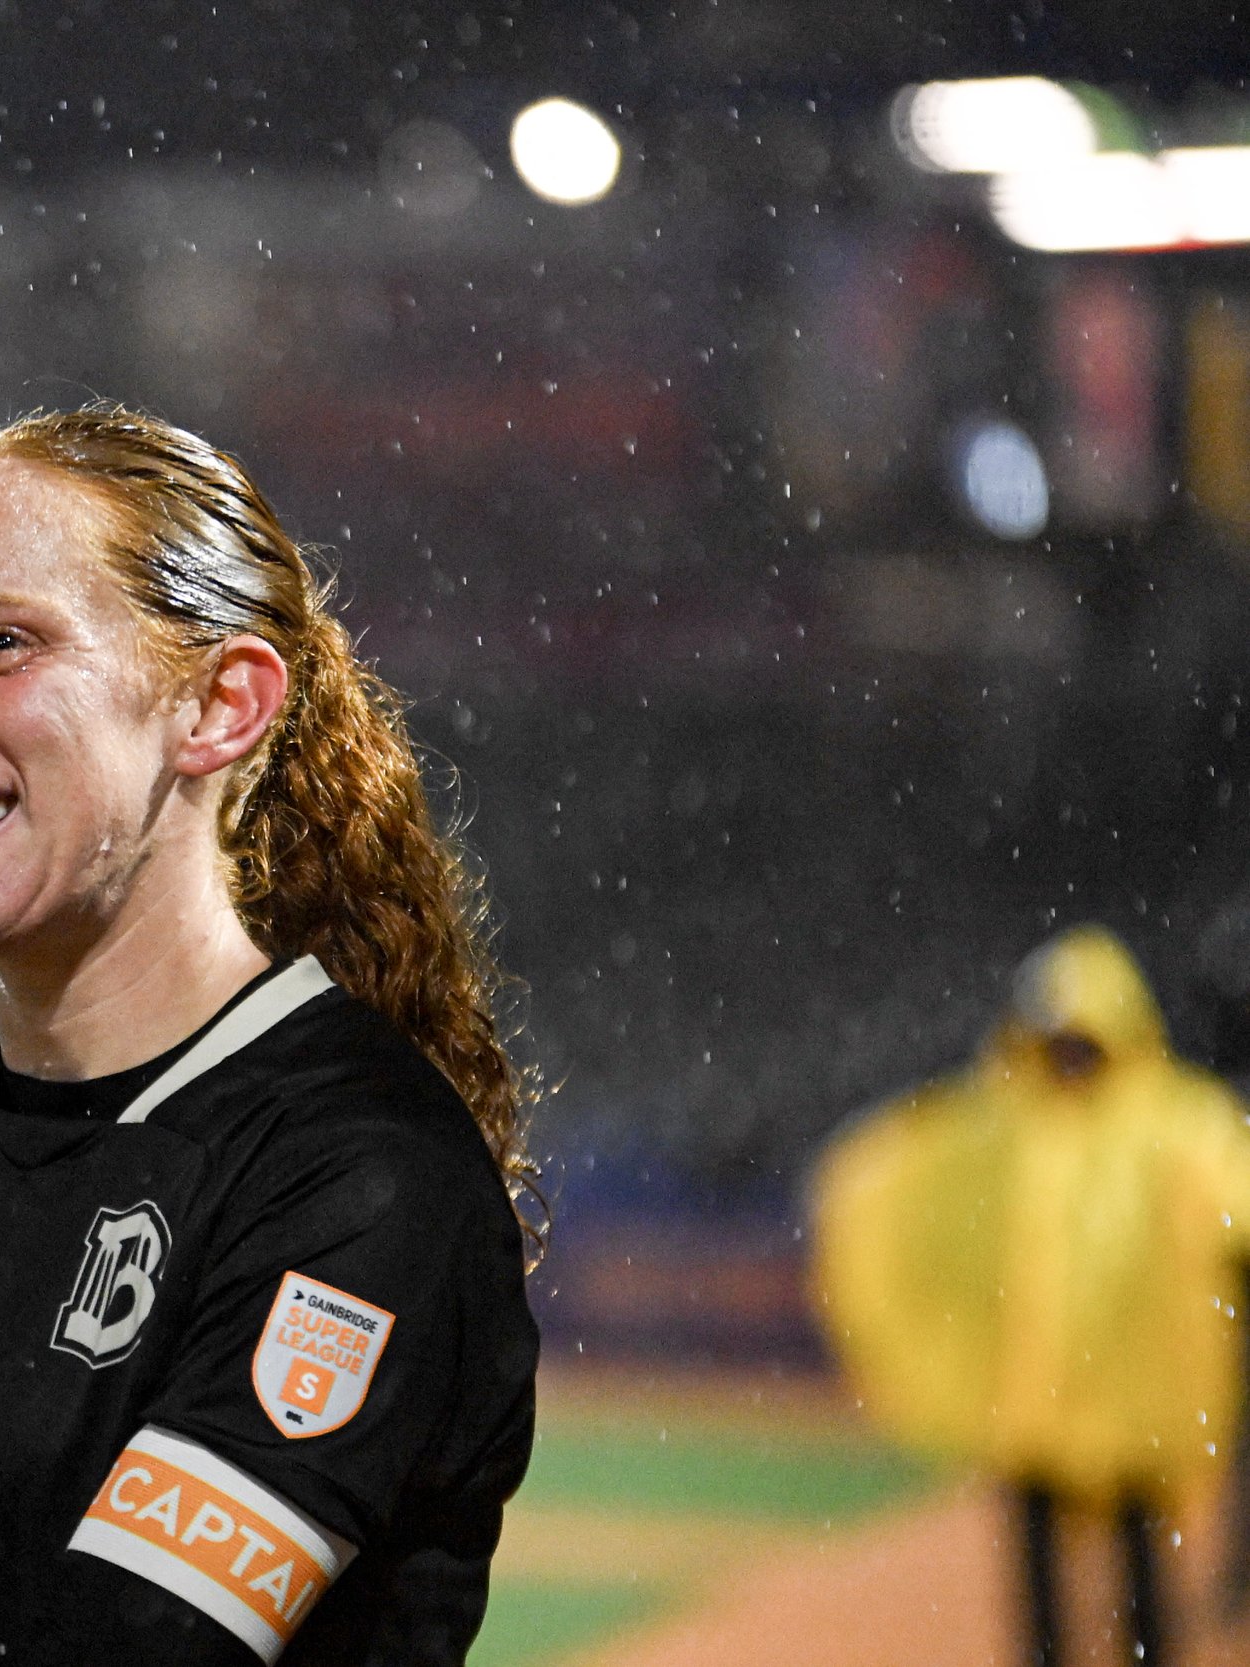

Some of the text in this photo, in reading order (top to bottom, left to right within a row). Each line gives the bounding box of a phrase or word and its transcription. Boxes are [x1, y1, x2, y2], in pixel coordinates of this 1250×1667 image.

[285, 1306, 370, 1355] SUPER
[308, 1295, 379, 1334] GAINBRIDGE
[276, 1325, 365, 1375] LEAGUE
[296, 1373, 319, 1400] S
